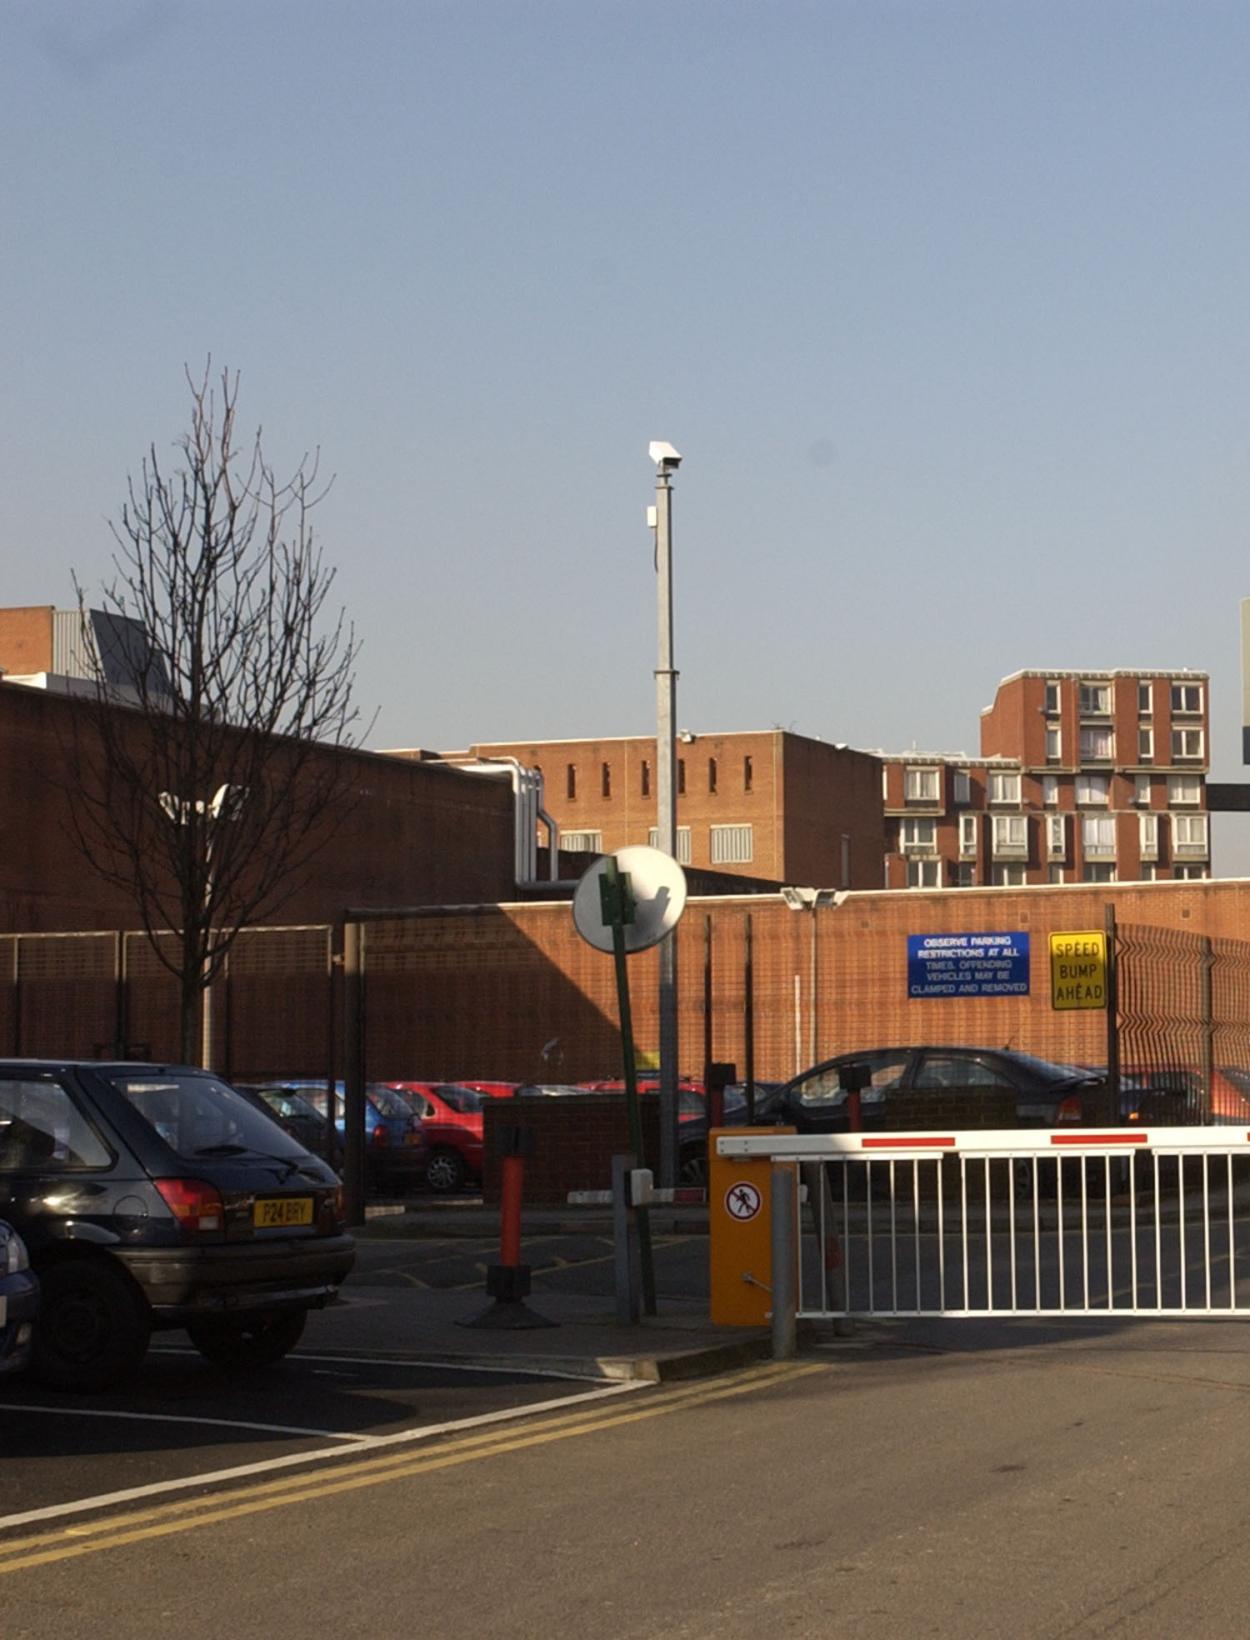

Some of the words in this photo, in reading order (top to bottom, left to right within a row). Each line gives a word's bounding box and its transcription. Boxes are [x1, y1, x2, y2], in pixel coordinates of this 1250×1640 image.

[923, 938, 968, 948] OBSERVE
[971, 936, 1011, 946] PARKING
[918, 948, 984, 959] RESTRICTIONS
[988, 948, 999, 957] AT
[1002, 948, 1020, 957] ALL
[1056, 942, 1100, 957] SPEED
[959, 960, 1012, 969] OFFENDING
[927, 971, 972, 981] VEHICLES
[975, 970, 993, 979] MAY
[997, 970, 1010, 979] BE
[1060, 964, 1096, 979] BUMP
[911, 984, 956, 994] CLAMPED
[959, 983, 978, 993] AND
[982, 982, 1027, 992] REMOVED
[1057, 984, 1102, 1000] AHEAD
